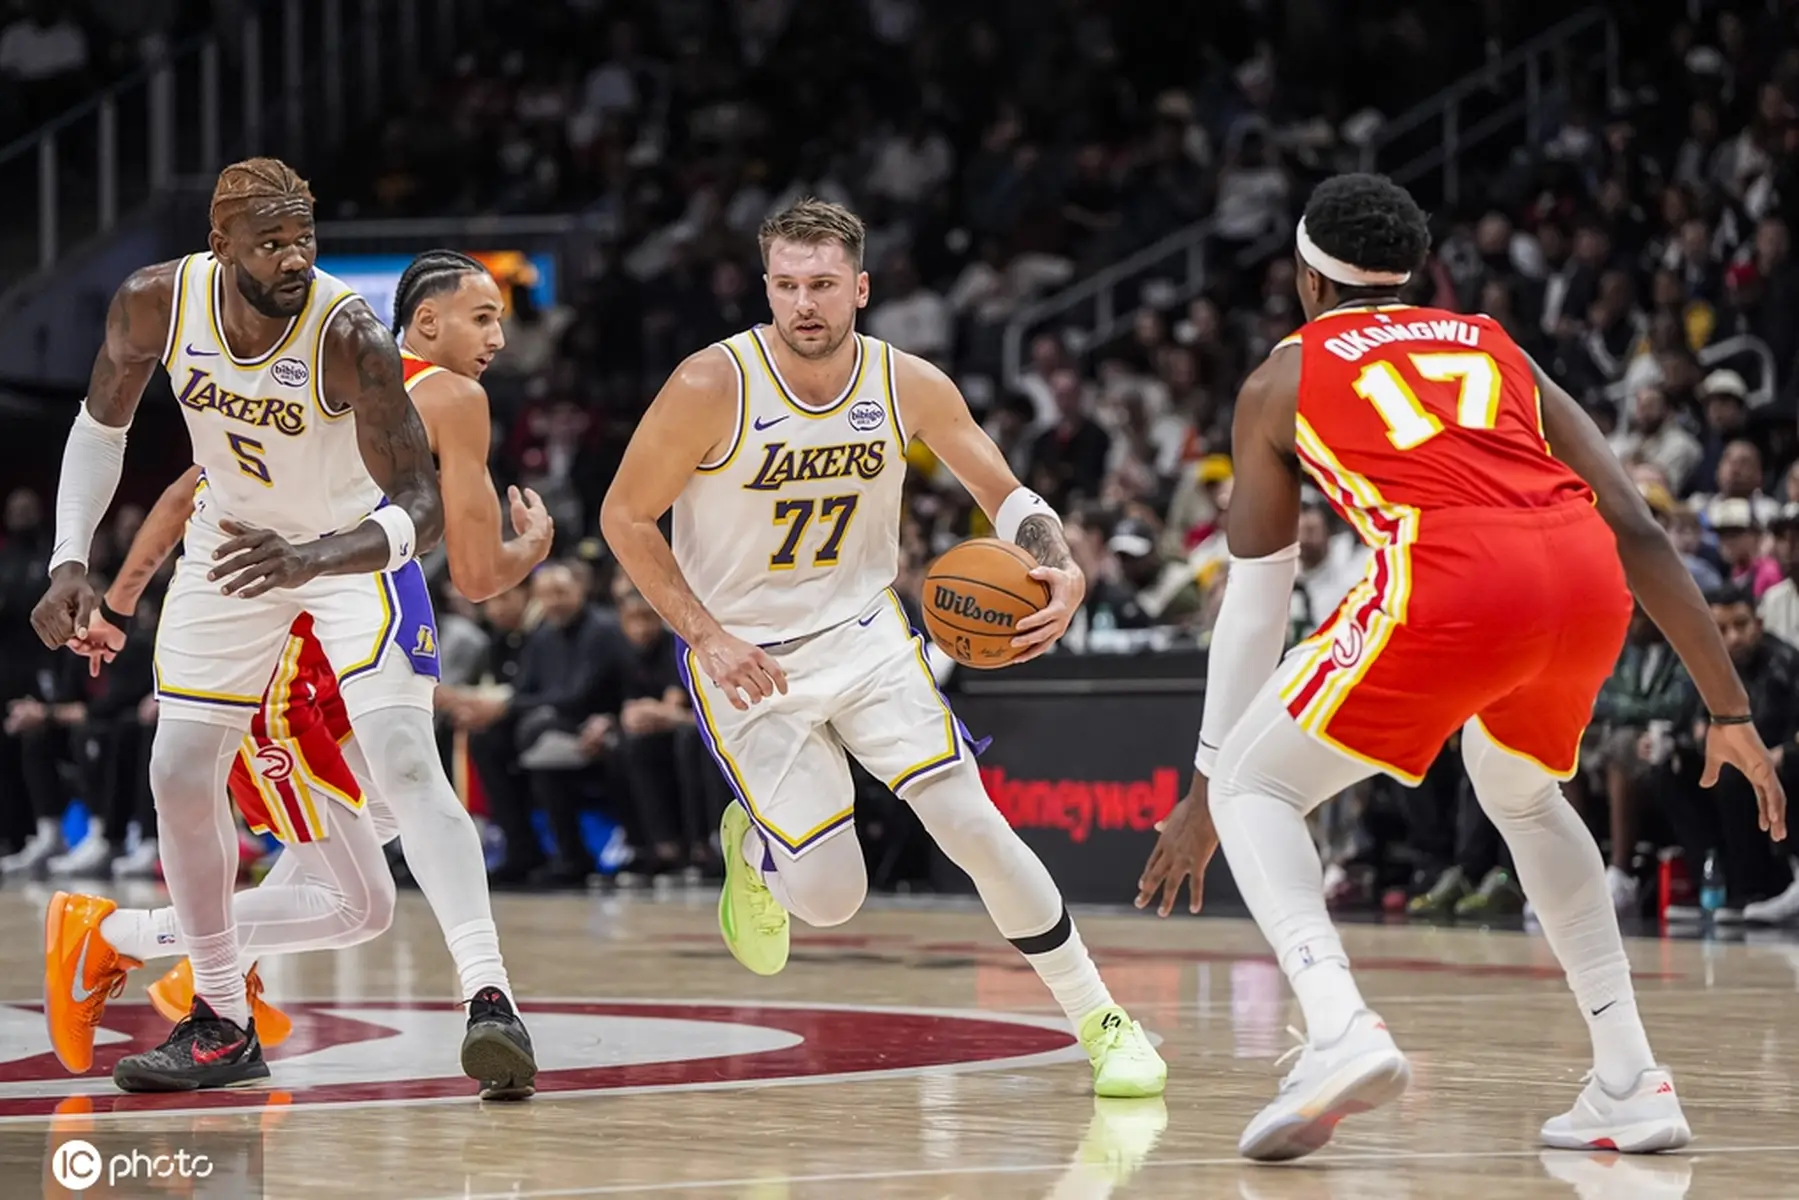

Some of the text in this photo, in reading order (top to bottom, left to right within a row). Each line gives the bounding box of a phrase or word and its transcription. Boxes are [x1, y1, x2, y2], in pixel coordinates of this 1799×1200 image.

[1323, 319, 1480, 362] OKONGWU
[178, 366, 306, 437] LAKERS
[1351, 351, 1502, 451] 17
[225, 431, 274, 488] 5
[742, 439, 887, 491] LAKERS
[768, 492, 860, 571] 77
[933, 583, 1014, 628] Wilson
